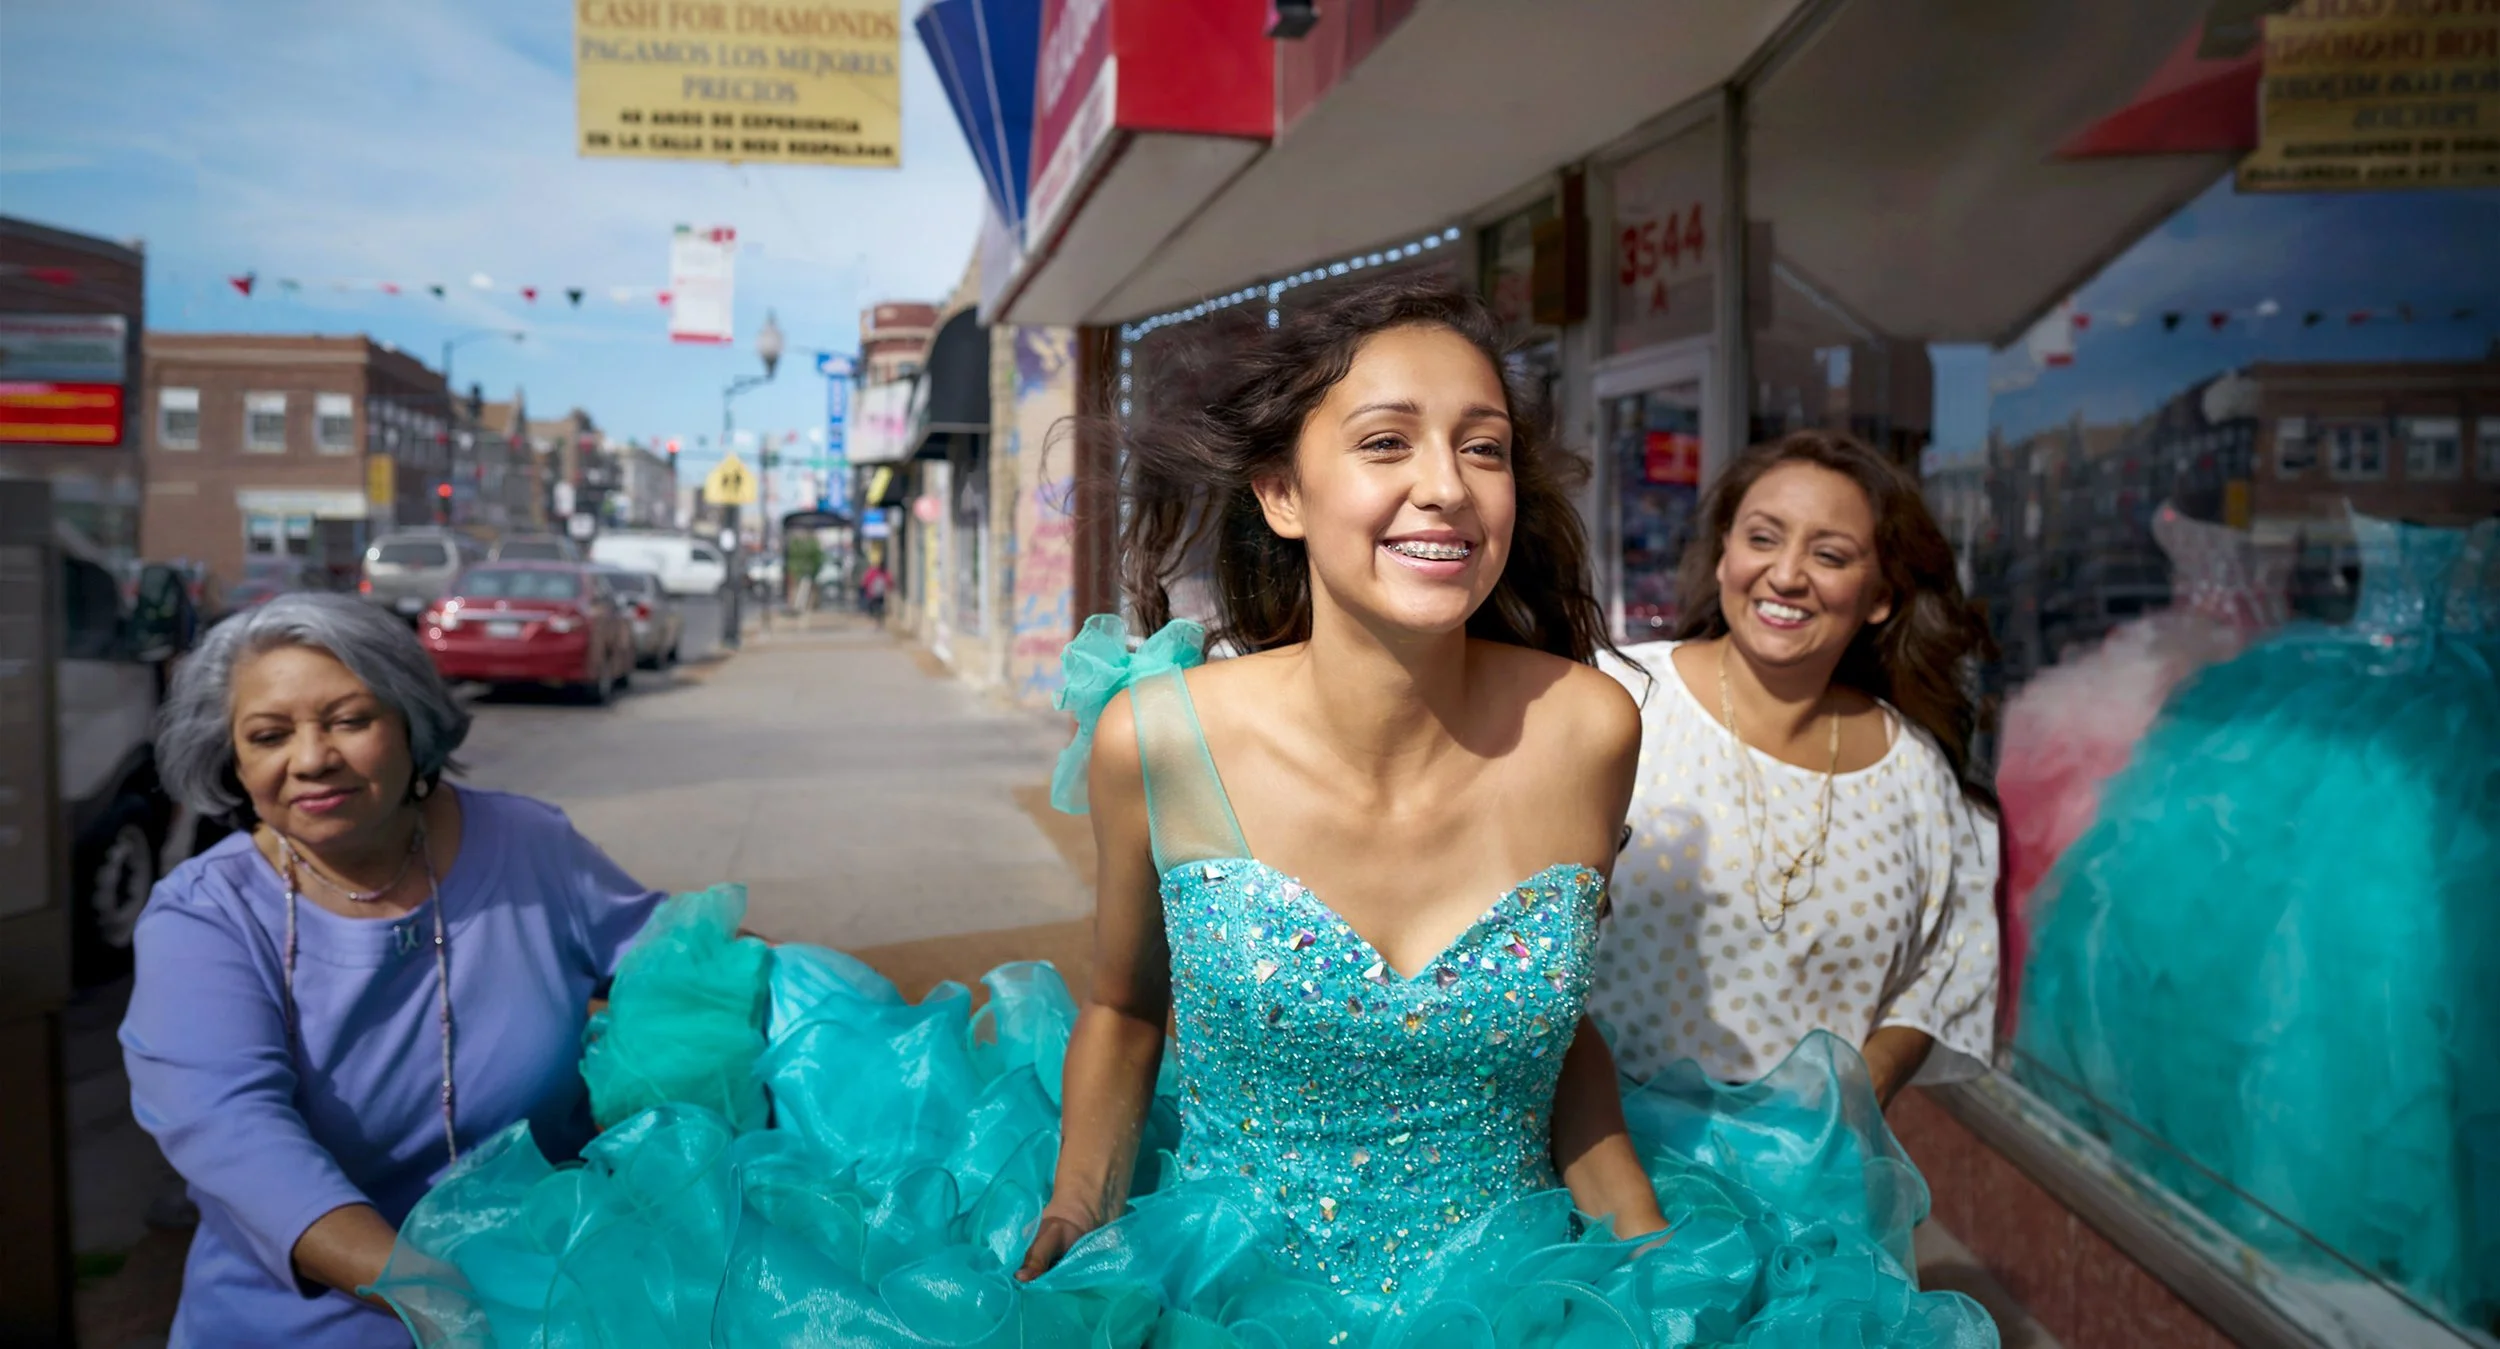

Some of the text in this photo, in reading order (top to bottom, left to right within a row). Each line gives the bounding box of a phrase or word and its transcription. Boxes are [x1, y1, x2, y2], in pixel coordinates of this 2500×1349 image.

[580, 0, 660, 28] CASH
[667, 2, 730, 33] FOR
[581, 36, 896, 79] PAGAMOS LOS MEJORES
[682, 74, 798, 104] PRECIOS
[1620, 202, 1705, 287] 3544
[1649, 279, 1669, 317] A
